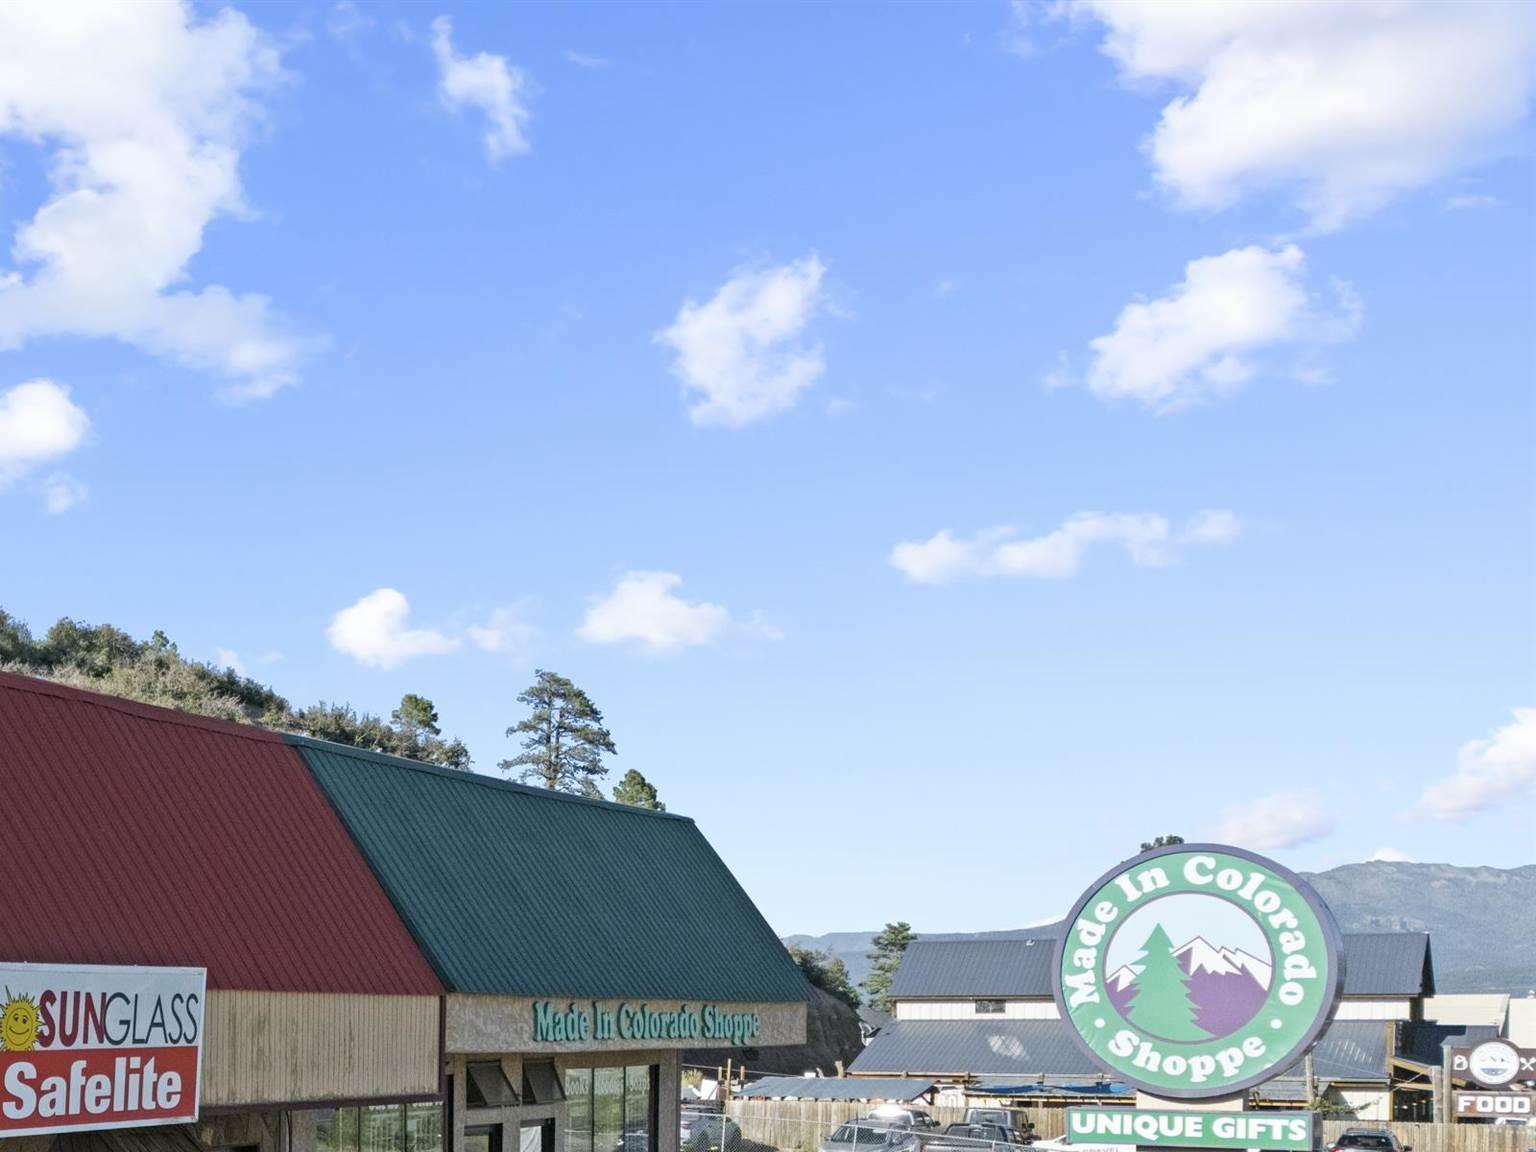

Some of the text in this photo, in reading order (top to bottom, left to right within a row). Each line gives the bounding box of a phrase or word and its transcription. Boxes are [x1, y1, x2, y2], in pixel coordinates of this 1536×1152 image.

[1064, 855, 1318, 1009] Made In Colorado
[38, 989, 199, 1048] SUNGLASS
[533, 1000, 761, 1046] Made In Colorado Shoppe
[1108, 1029, 1267, 1083] Shoppe
[2, 1055, 182, 1120] Safelite
[1457, 1095, 1531, 1114] FOOD
[1071, 1112, 1307, 1141] UNIQUE GIFTS
